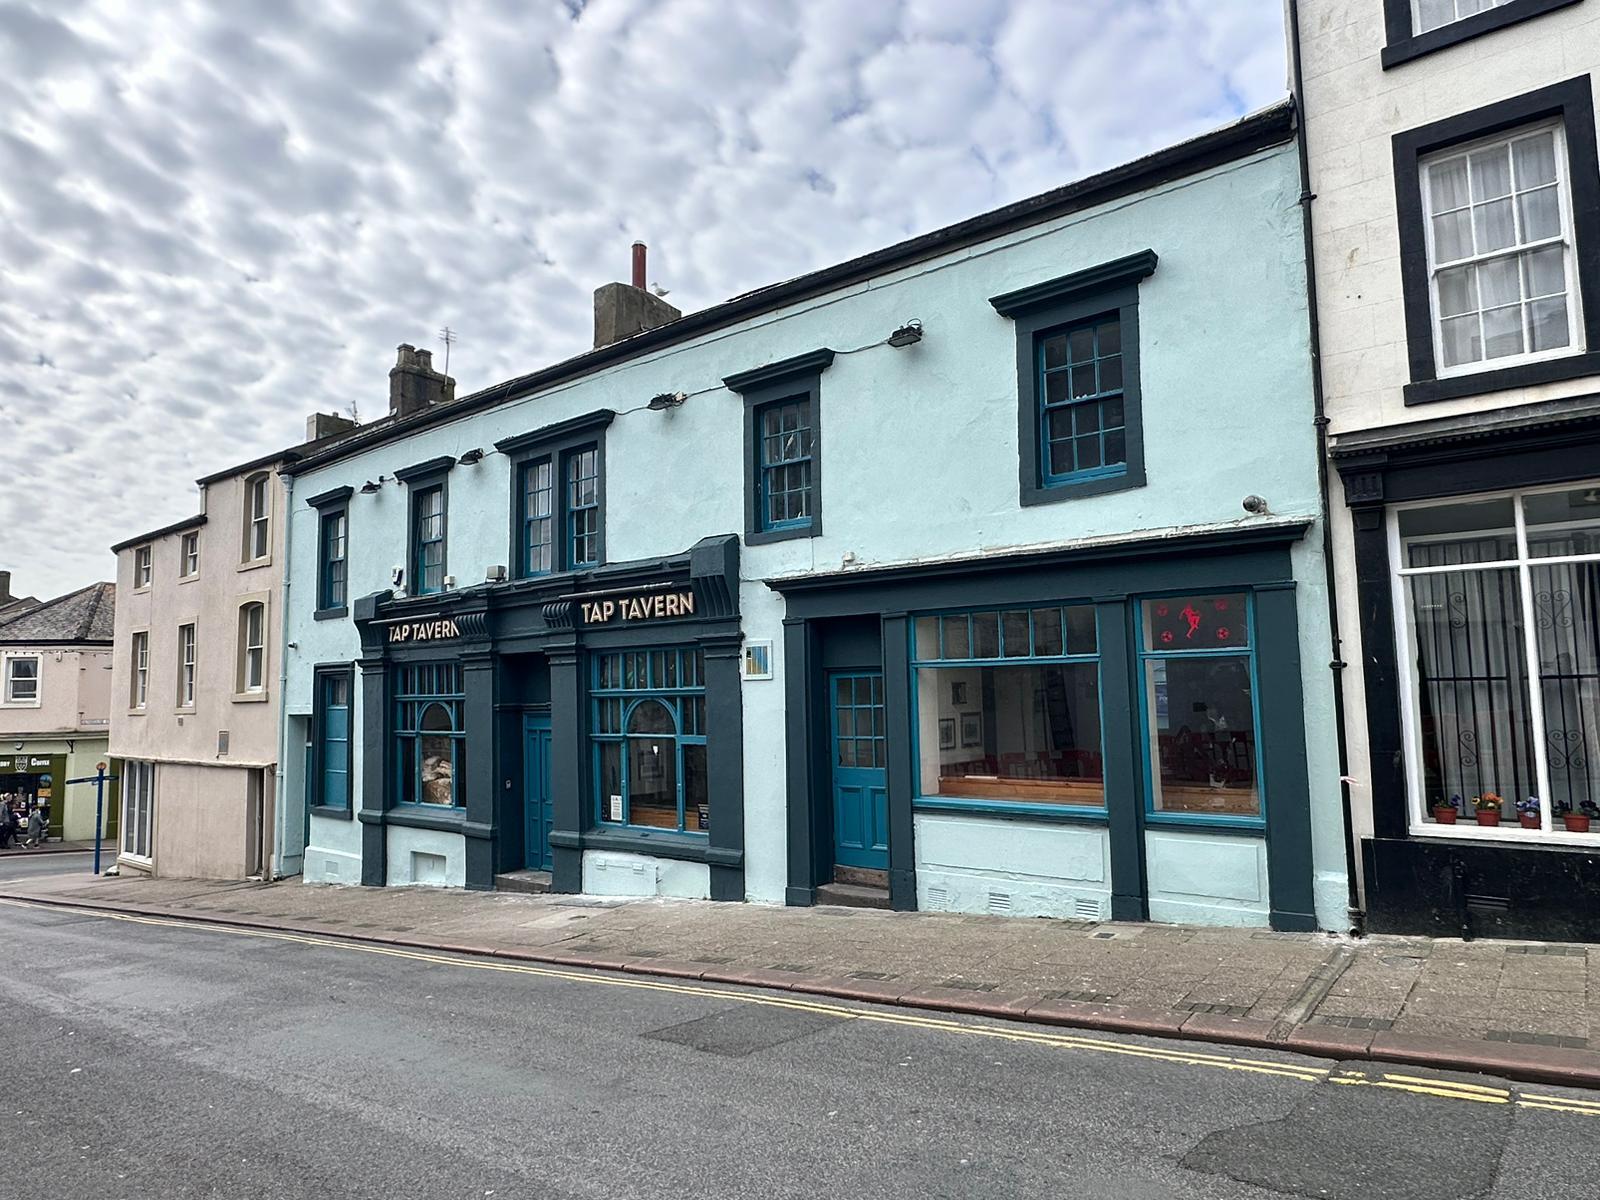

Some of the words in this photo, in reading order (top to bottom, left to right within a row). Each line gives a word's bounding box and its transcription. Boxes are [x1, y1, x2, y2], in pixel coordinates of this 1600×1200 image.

[581, 601, 614, 624] TAP
[619, 591, 694, 620] TAVERN
[389, 624, 410, 642] TAP
